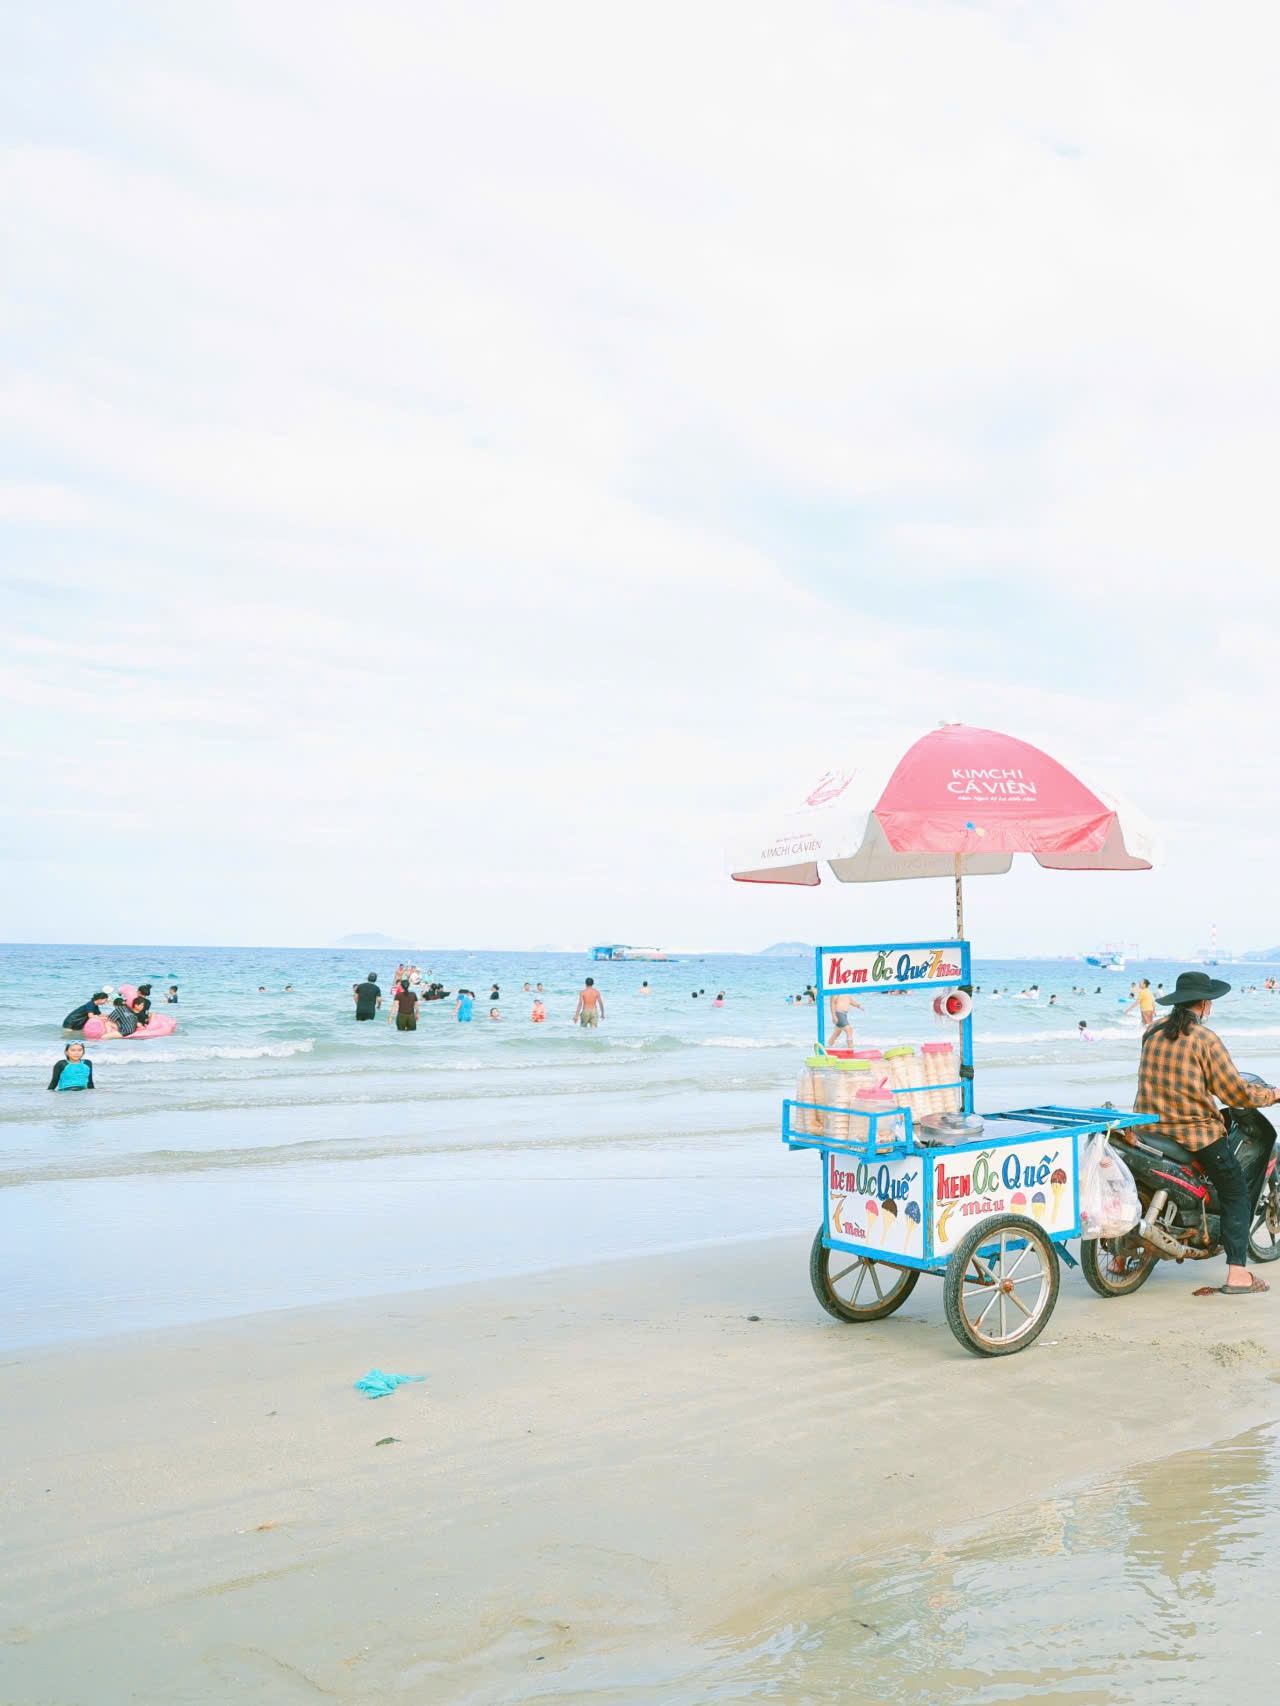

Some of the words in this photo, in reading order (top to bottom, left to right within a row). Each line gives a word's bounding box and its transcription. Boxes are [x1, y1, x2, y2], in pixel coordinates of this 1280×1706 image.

[946, 779, 982, 794] CÁ
[982, 779, 1037, 794] VIÊN
[951, 768, 1024, 779] KIMCHI
[829, 957, 868, 985] Kem
[872, 949, 893, 982] Ốc
[876, 1164, 918, 1202] Quế
[972, 1149, 1000, 1195] Ốc
[1002, 1151, 1059, 1190] Quế
[936, 1199, 960, 1243] 7
[960, 1196, 1006, 1217] màu
